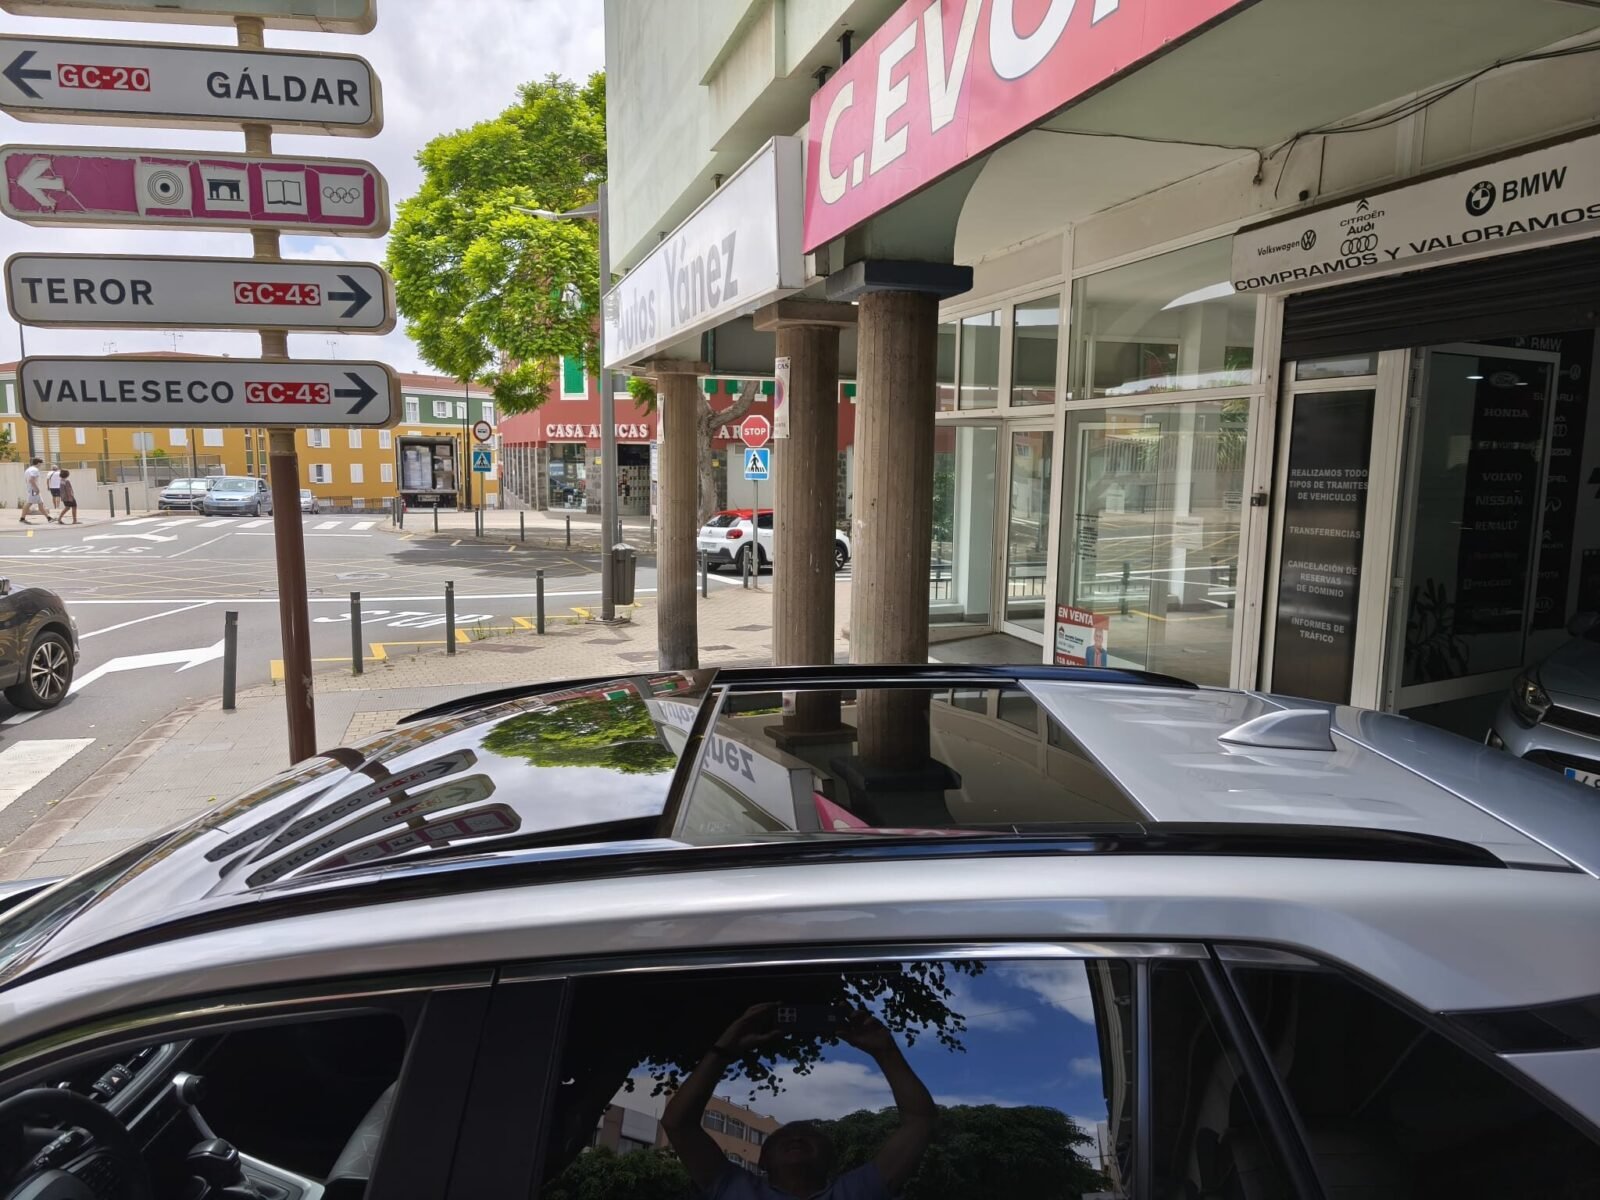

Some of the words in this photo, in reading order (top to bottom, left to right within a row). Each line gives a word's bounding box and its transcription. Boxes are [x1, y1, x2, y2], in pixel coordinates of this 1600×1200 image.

[58, 64, 150, 91] GC-20
[206, 67, 359, 106] GÁLDAR
[819, 0, 1120, 205] C.EVO
[1502, 166, 1567, 203] BMW
[1346, 222, 1375, 236] Audi
[1257, 240, 1300, 256] Volkswagen
[1234, 252, 1378, 291] COMPRAMOS
[1384, 246, 1400, 260] Y
[21, 277, 154, 306] TEROR
[235, 282, 321, 306] GC-43
[616, 285, 657, 354] Autos
[664, 230, 738, 328] Yánez
[33, 379, 234, 404] VALLESECO
[246, 382, 331, 404] GC-43
[1483, 407, 1529, 418] HONDA
[546, 423, 585, 438] CASA
[588, 423, 649, 438] ACAS
[744, 427, 767, 436] STOP
[1291, 469, 1342, 478] REALIZAMOS
[1481, 472, 1522, 482] VOLVO
[1288, 481, 1312, 489] TIPOS
[1313, 481, 1325, 489] DE
[1297, 492, 1308, 500] DE
[1475, 495, 1523, 506] NISSAN
[1288, 525, 1361, 540] TRANSFERENCIAS
[1345, 566, 1358, 575] DE
[1300, 572, 1342, 586] RESERVAS
[1296, 584, 1307, 593] DE
[1308, 585, 1344, 598] DOMINIO
[1058, 607, 1069, 619] EN
[1069, 608, 1094, 626] VENTA
[1291, 617, 1332, 631] INFORMES
[1333, 624, 1345, 634] DE
